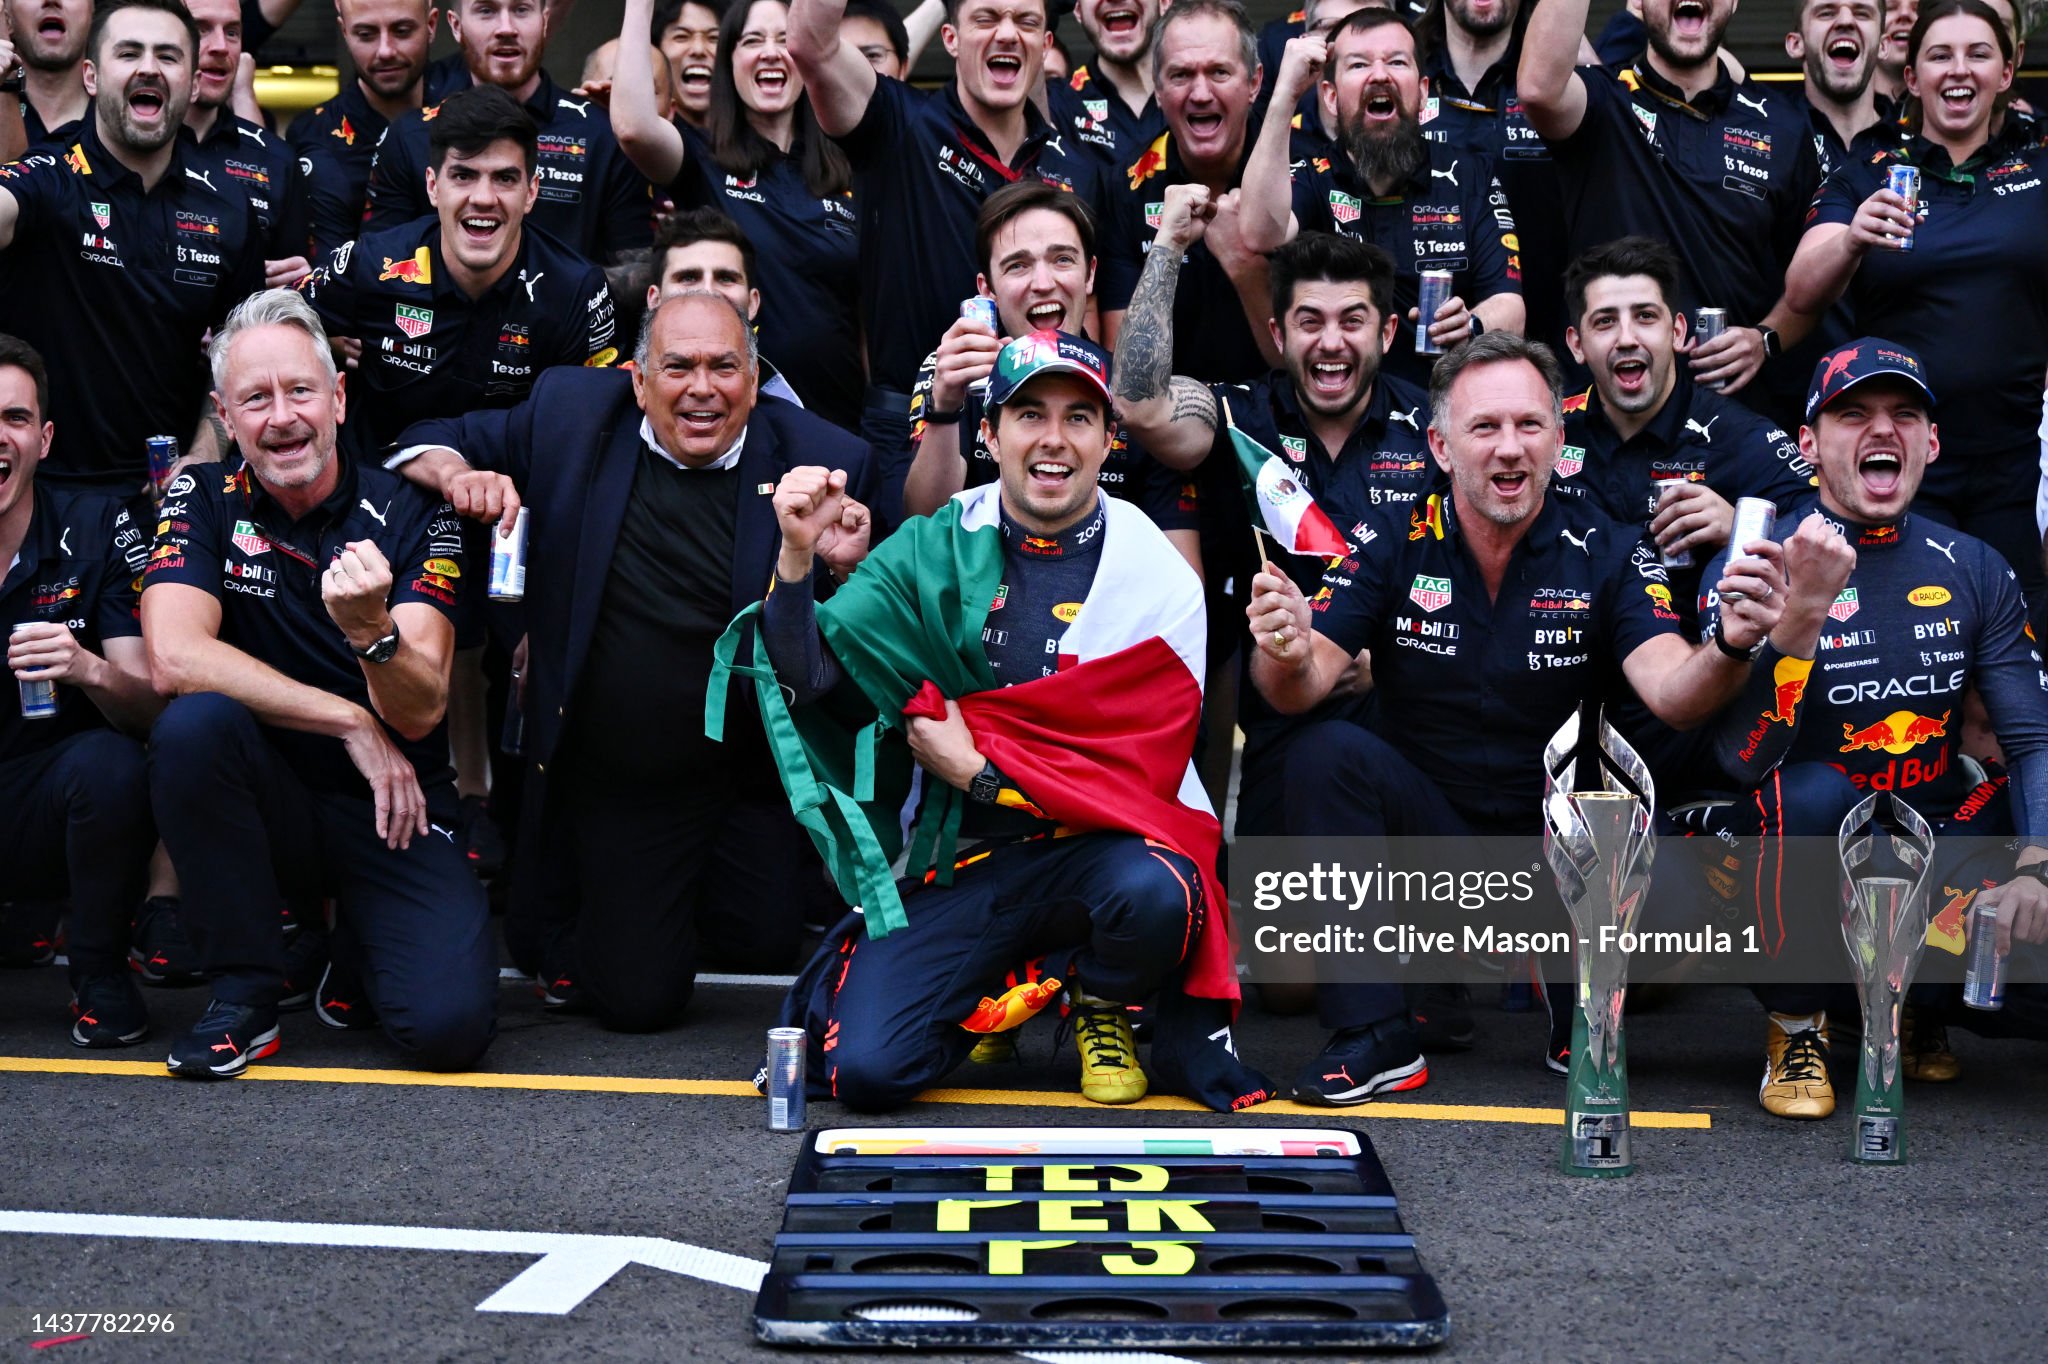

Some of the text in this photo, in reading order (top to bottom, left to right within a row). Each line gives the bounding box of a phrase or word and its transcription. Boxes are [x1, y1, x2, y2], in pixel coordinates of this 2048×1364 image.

[537, 135, 587, 146] ORACLE
[1519, 127, 1540, 139] Tez
[1723, 126, 1772, 143] ORACLE
[547, 167, 583, 182] Tezos
[1737, 160, 1769, 180] Tezos
[2005, 178, 2042, 193] Tezos
[250, 198, 269, 210] zos
[1333, 192, 1360, 209] TAG
[92, 203, 109, 216] AG
[1412, 205, 1460, 214] ORACLE
[175, 211, 219, 225] ORACLE
[1428, 240, 1466, 253] Tezos
[189, 248, 221, 264] Tezos
[399, 305, 430, 322] TAG
[397, 314, 431, 338] HEUER
[501, 323, 529, 335] ACLE
[381, 337, 421, 358] Mobil
[381, 354, 433, 375] ORACLE
[1010, 344, 1037, 370] 11
[492, 360, 531, 376] Tezos
[1372, 451, 1425, 462] ORACLE
[1556, 460, 1582, 477] EUER
[1652, 461, 1705, 471] ORACLE
[1097, 472, 1125, 482] zos
[1384, 489, 1418, 502] Tezo
[233, 533, 270, 555] HEUER
[160, 557, 186, 569] Bull
[224, 558, 262, 579] Mobil
[223, 580, 276, 598] ORACLE
[1415, 576, 1449, 592] TAG
[1411, 589, 1449, 610] HEUER
[1534, 588, 1592, 600] ORACLE
[1919, 591, 1948, 601] RAUCH
[1530, 599, 1563, 609] Red Bull
[1529, 611, 1590, 620] RACING
[1396, 616, 1442, 637] Mobil
[1914, 617, 1961, 640] BYBIT
[1535, 626, 1583, 645] BYBIT
[1819, 635, 1860, 651] Mobil
[1396, 636, 1457, 656] ORACLE
[1544, 653, 1589, 668] Tezos
[1933, 650, 1965, 663] Tezos
[1827, 669, 1965, 705] ORACLE
[1738, 718, 1771, 763] Red Bull
[1900, 743, 1950, 789] Bull
[1954, 780, 1997, 822] WINGS
[1864, 1134, 1889, 1151] 3
